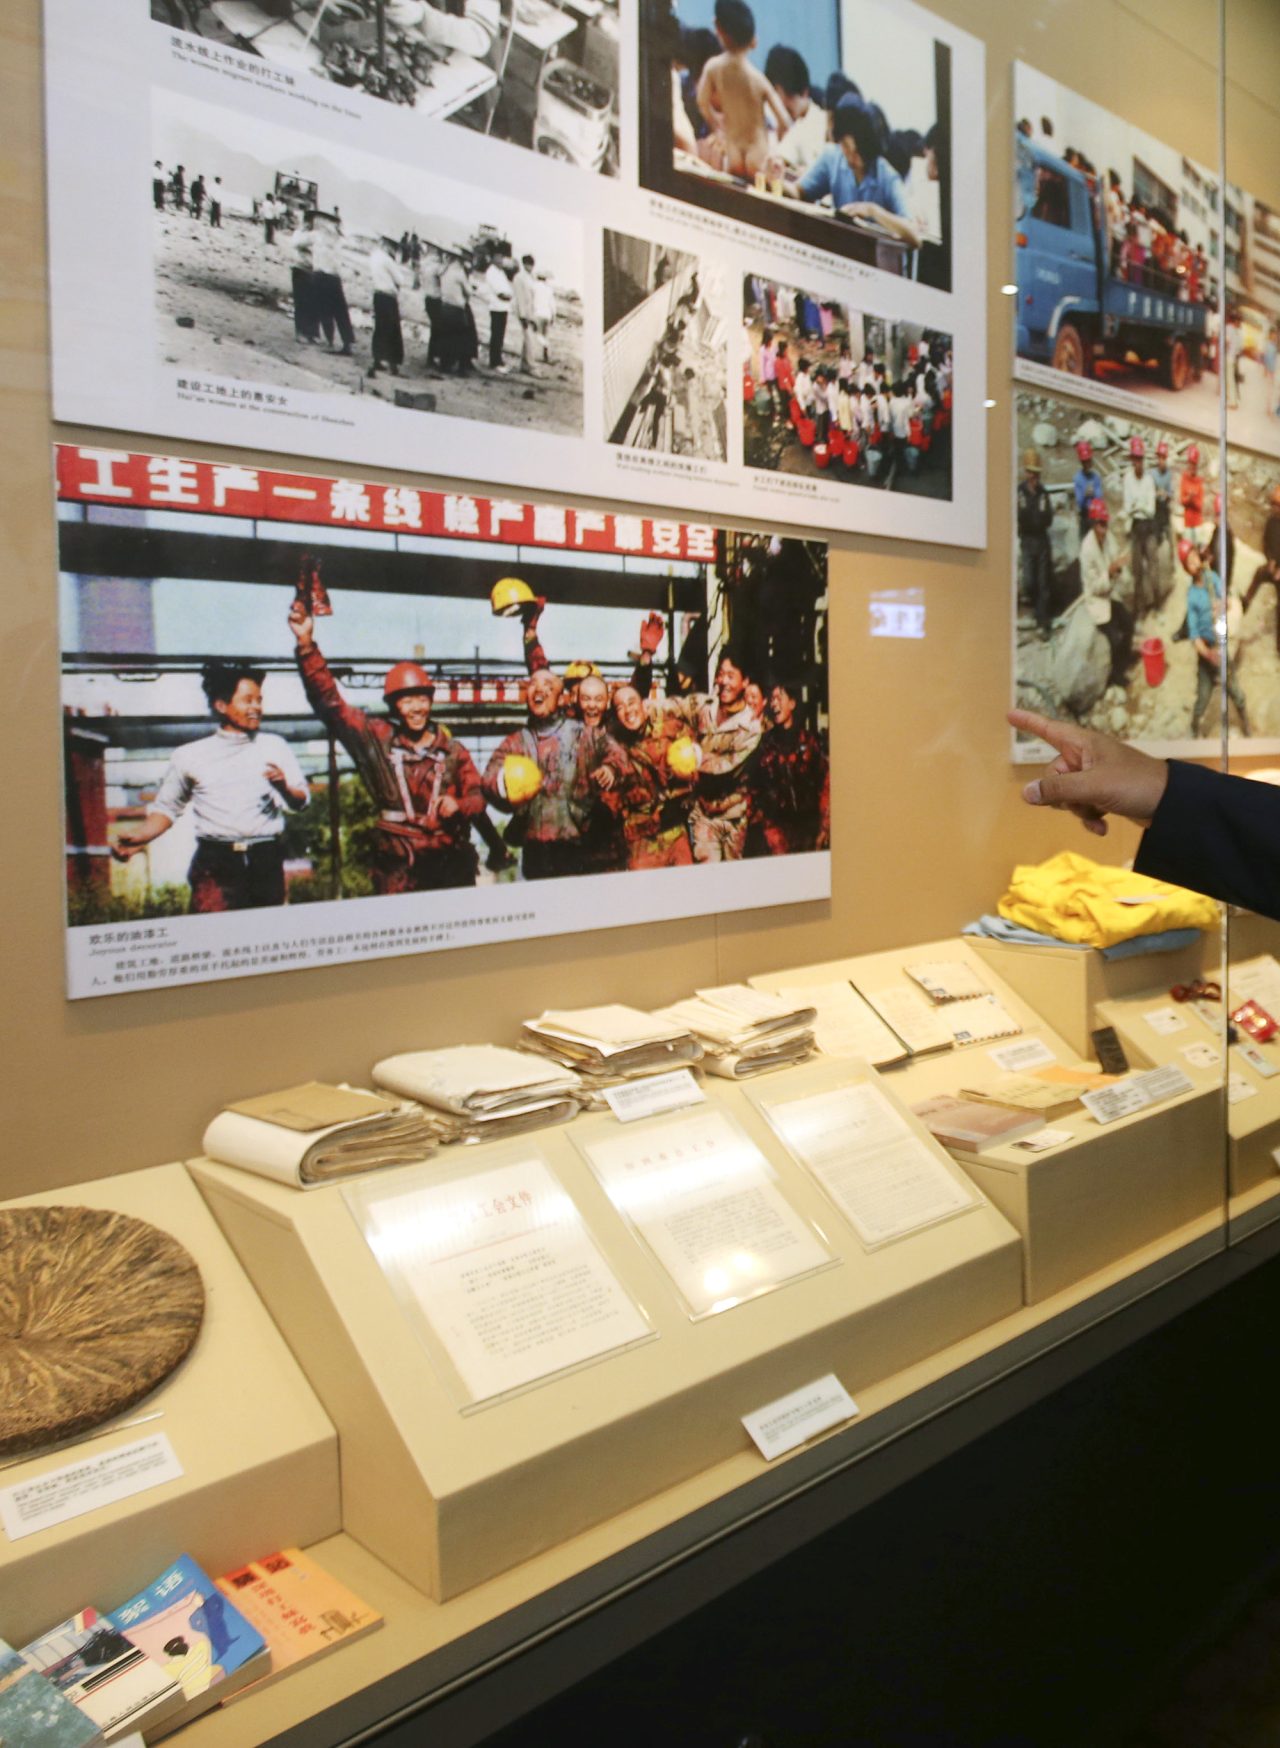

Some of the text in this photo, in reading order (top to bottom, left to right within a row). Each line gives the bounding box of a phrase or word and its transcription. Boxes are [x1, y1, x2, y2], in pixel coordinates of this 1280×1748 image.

[56, 445, 422, 528] 工生产一条线
[89, 927, 168, 946] 欢乐的油漆工
